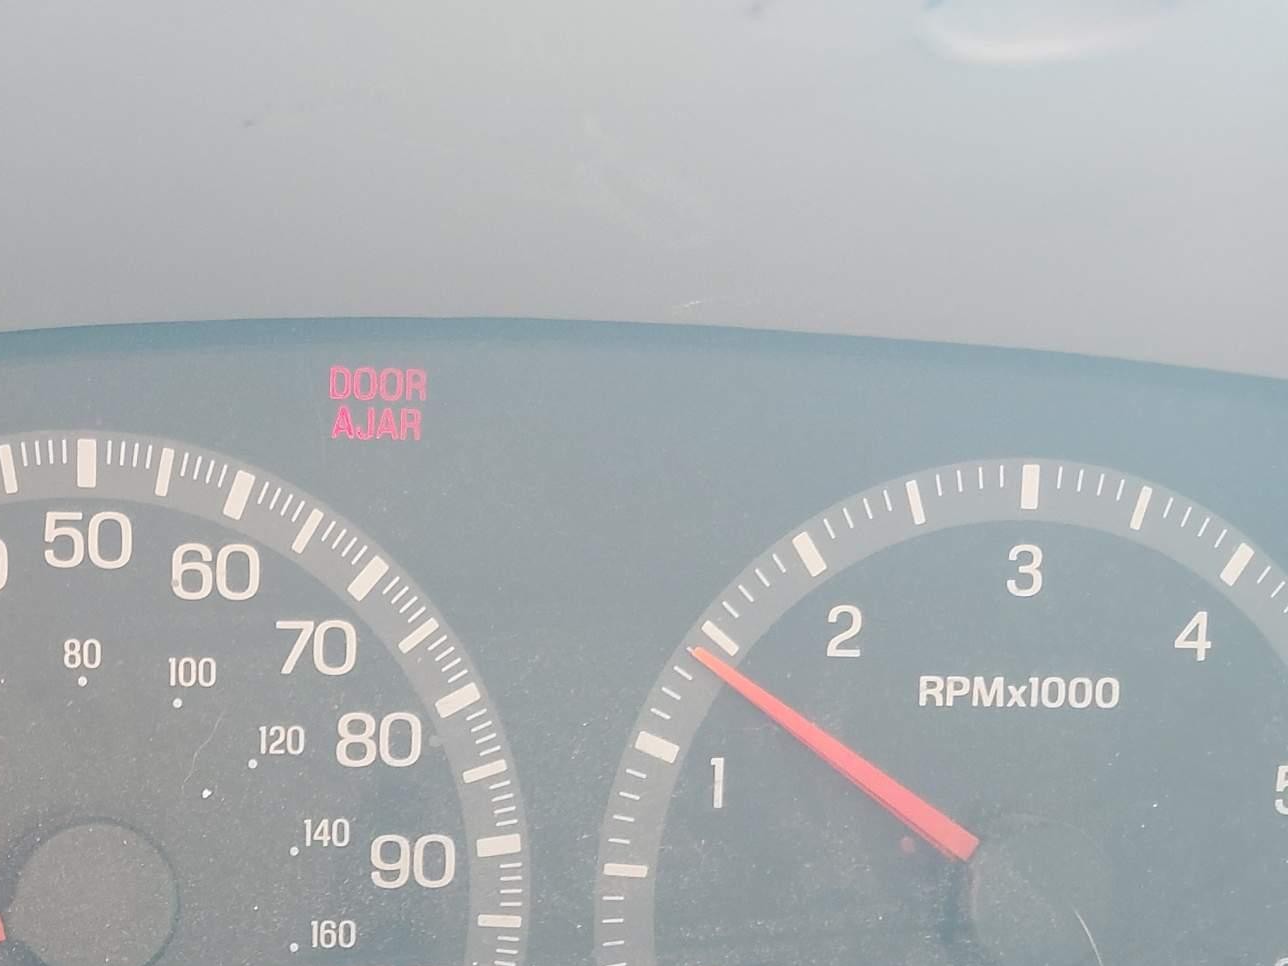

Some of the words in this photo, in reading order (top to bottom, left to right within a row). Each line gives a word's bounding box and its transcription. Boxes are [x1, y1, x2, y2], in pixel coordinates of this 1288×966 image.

[329, 366, 427, 400] DOOR
[331, 406, 422, 441] AJAR
[44, 511, 133, 569] 50
[171, 543, 261, 601] 60
[1006, 544, 1043, 597] 3
[63, 638, 102, 670] 80
[275, 620, 358, 676] 70
[826, 605, 862, 657] 2
[1174, 611, 1212, 661] 4
[168, 657, 217, 688] 100
[918, 675, 1120, 709] RPMx1000
[259, 725, 305, 755] 120
[335, 711, 423, 768] 80
[710, 756, 725, 809] 1
[304, 818, 350, 848] 140
[370, 834, 456, 889] 90
[311, 920, 357, 949] 160
